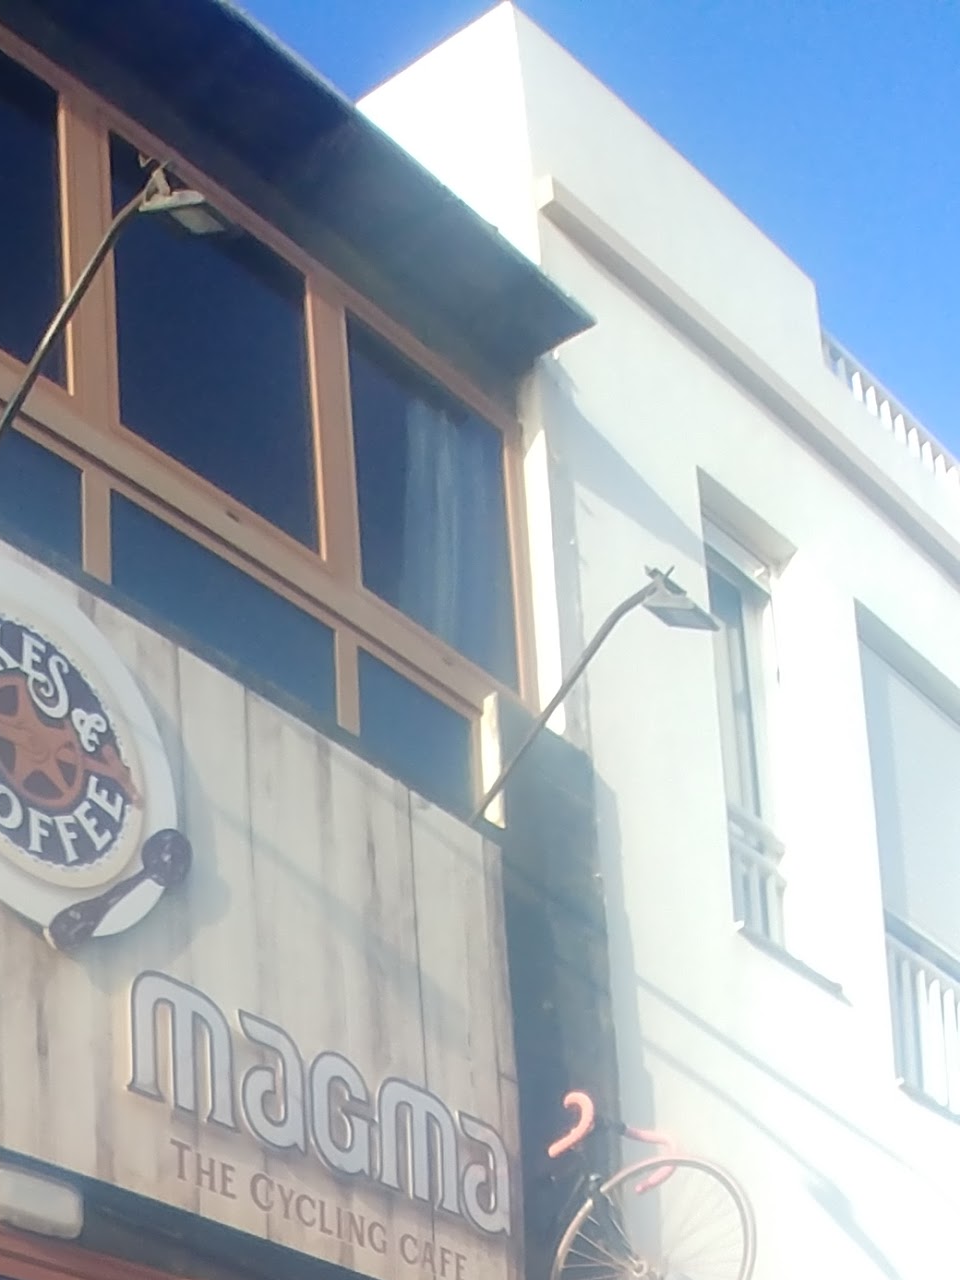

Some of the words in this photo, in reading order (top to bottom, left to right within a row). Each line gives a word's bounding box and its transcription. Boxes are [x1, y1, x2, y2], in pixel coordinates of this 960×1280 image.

[71, 707, 108, 752] &
[170, 1137, 238, 1200] THE
[249, 1172, 388, 1255] CYCLING
